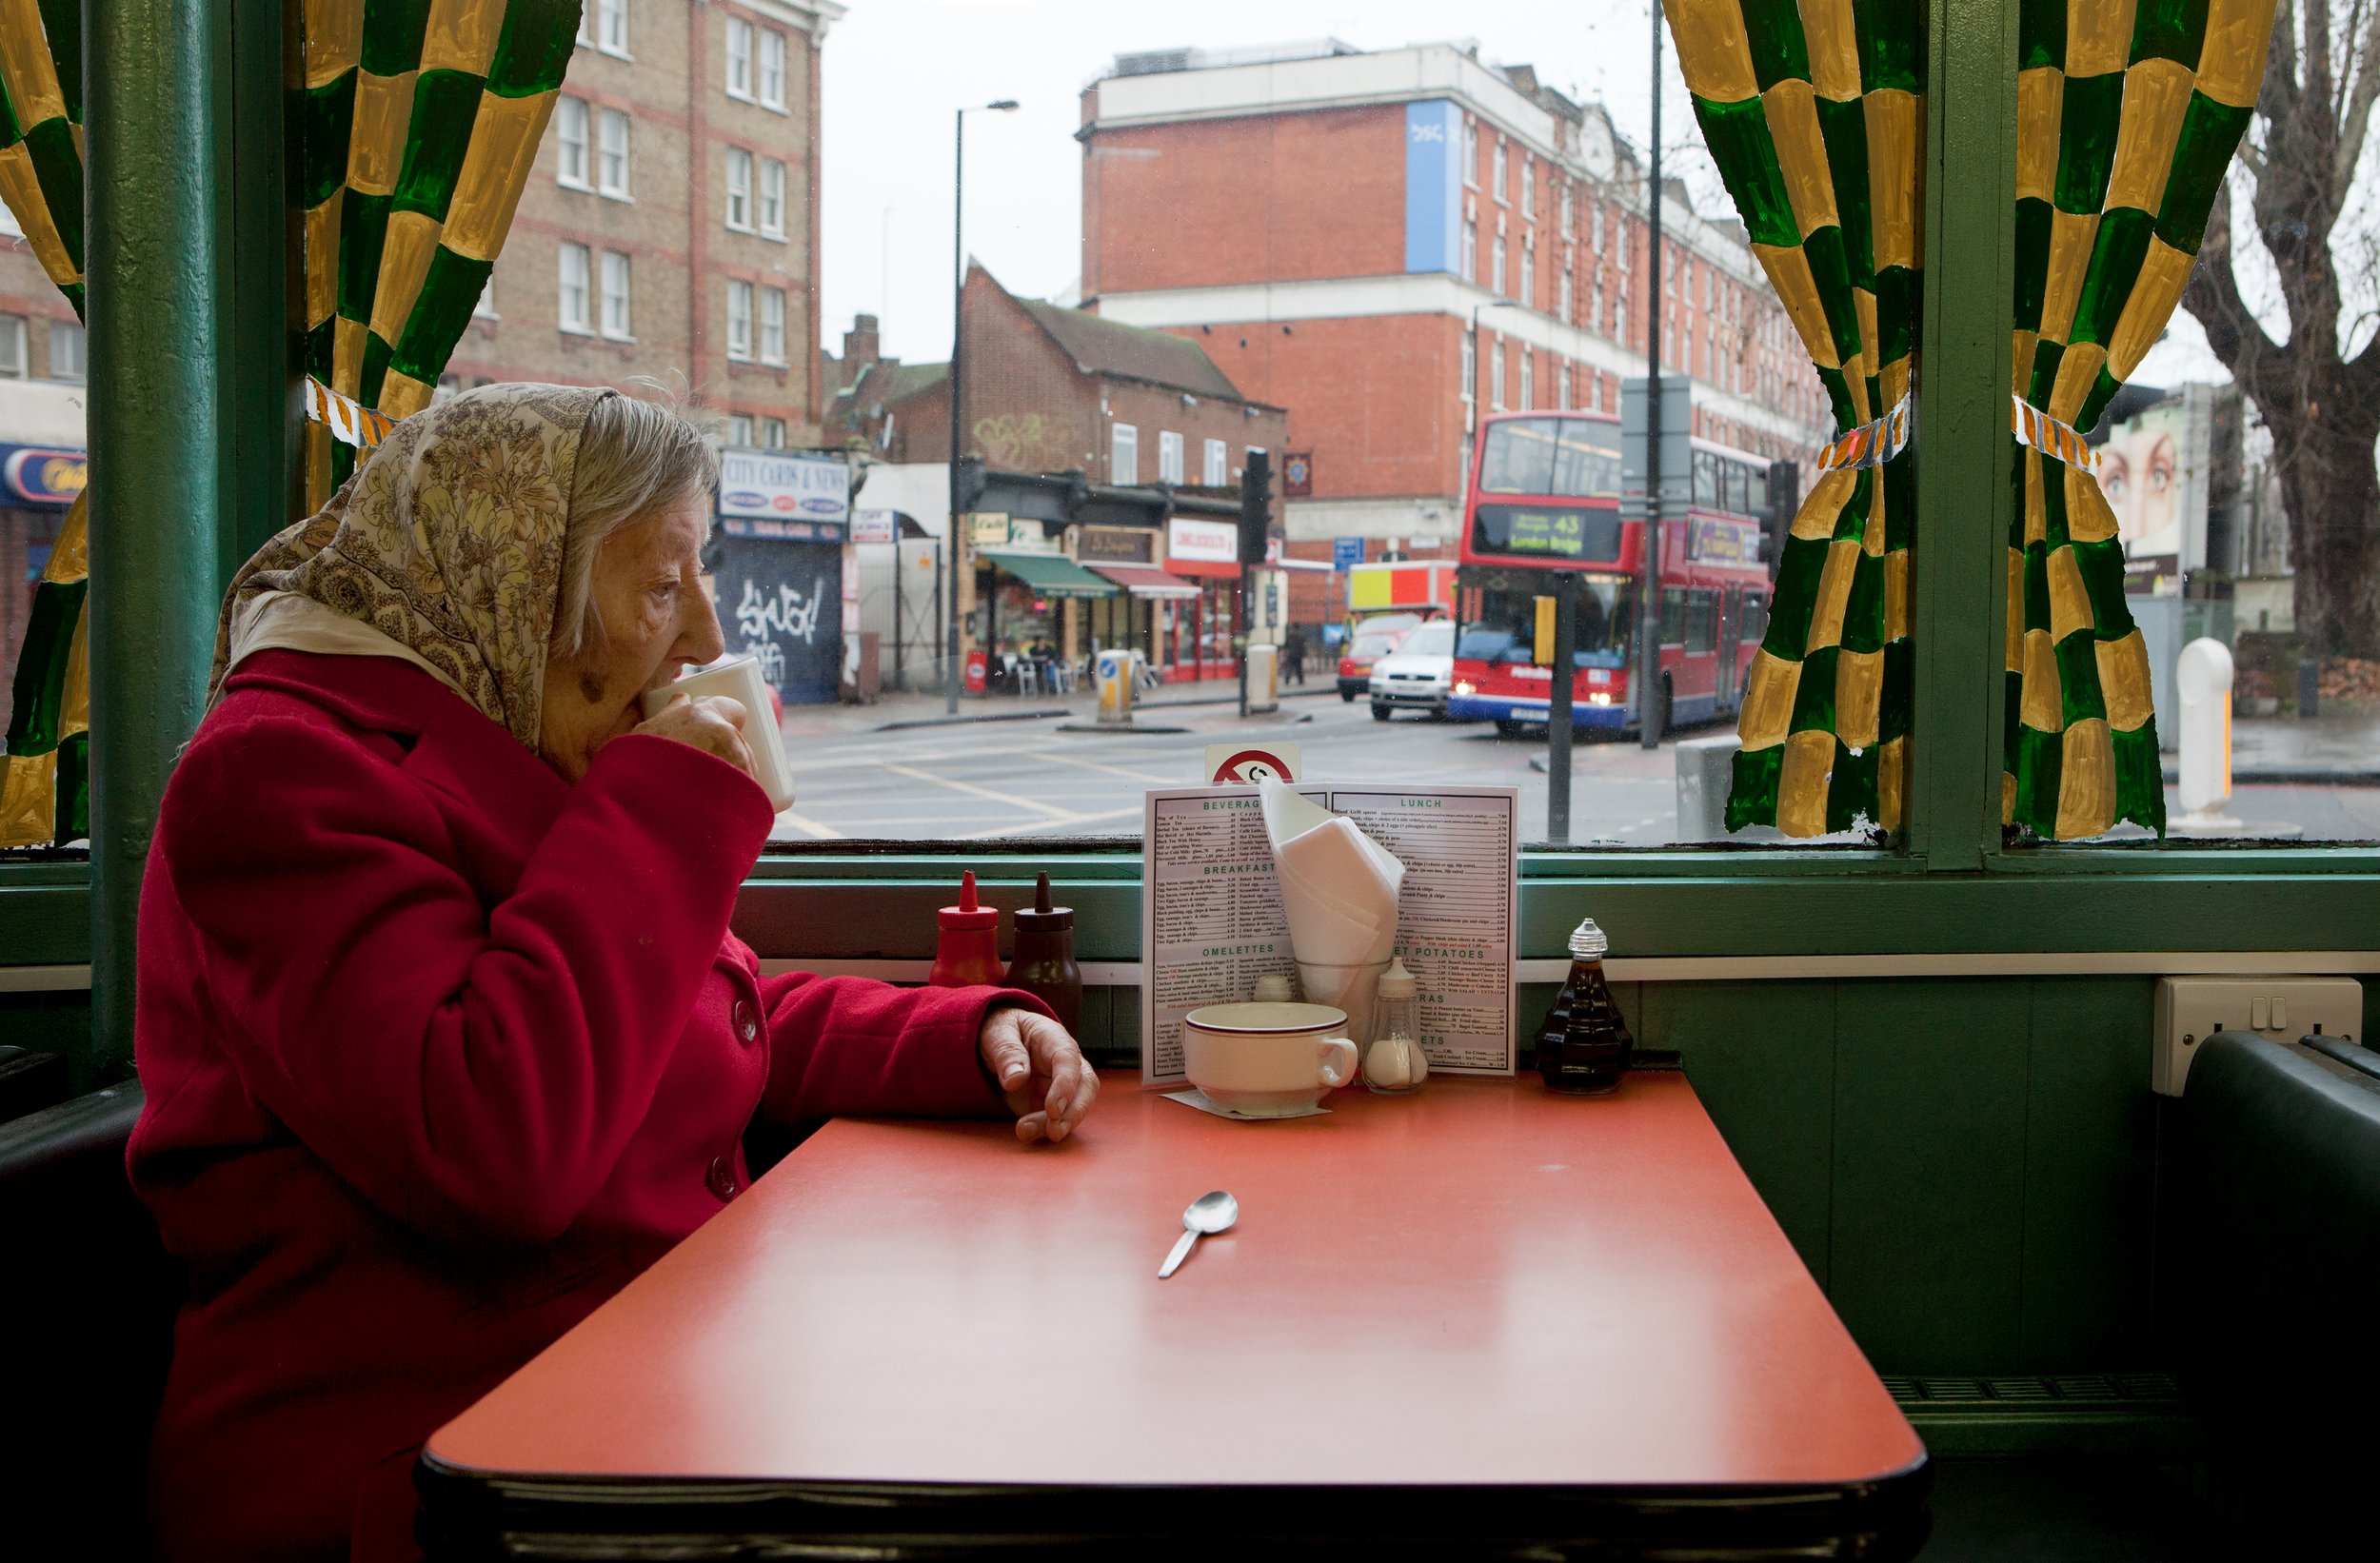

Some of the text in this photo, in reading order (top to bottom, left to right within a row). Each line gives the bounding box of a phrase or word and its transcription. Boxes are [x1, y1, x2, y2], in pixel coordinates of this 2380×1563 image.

[725, 459, 845, 491] CITY CARDS & NEWS
[1555, 515, 1578, 534] 43
[1203, 801, 1259, 810] BEVERAG
[1400, 799, 1442, 808] LUNCH
[1204, 863, 1276, 875] BREAKFAST
[1202, 944, 1273, 957] OMELETTES
[1416, 948, 1484, 959] POTATOES
[1419, 994, 1445, 1003] RAS
[1420, 1036, 1444, 1045] ETS
